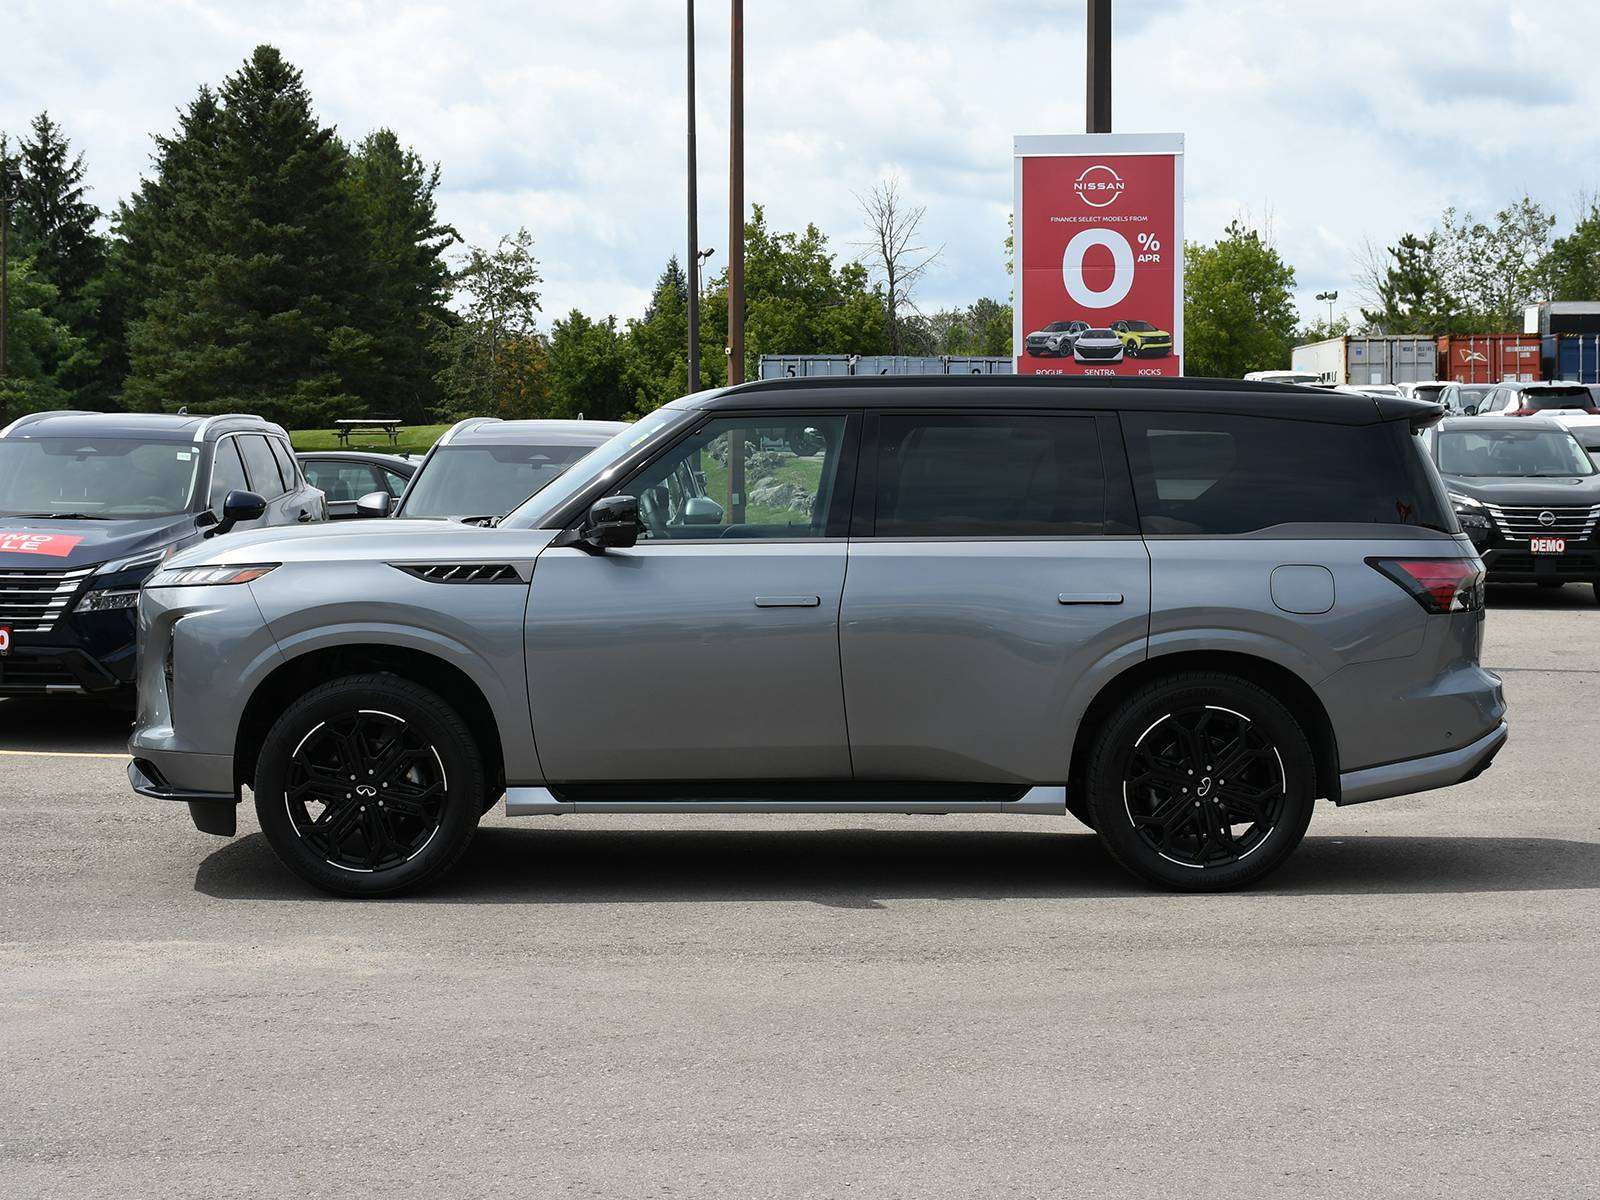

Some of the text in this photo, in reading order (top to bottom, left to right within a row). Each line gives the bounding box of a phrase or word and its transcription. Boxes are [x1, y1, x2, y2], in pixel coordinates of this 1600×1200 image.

[1074, 182, 1125, 190] NISSAN
[1137, 254, 1160, 263] APR
[1062, 228, 1160, 309] 0 %
[1138, 368, 1162, 376] KICKS
[1531, 539, 1565, 552] DEMO
